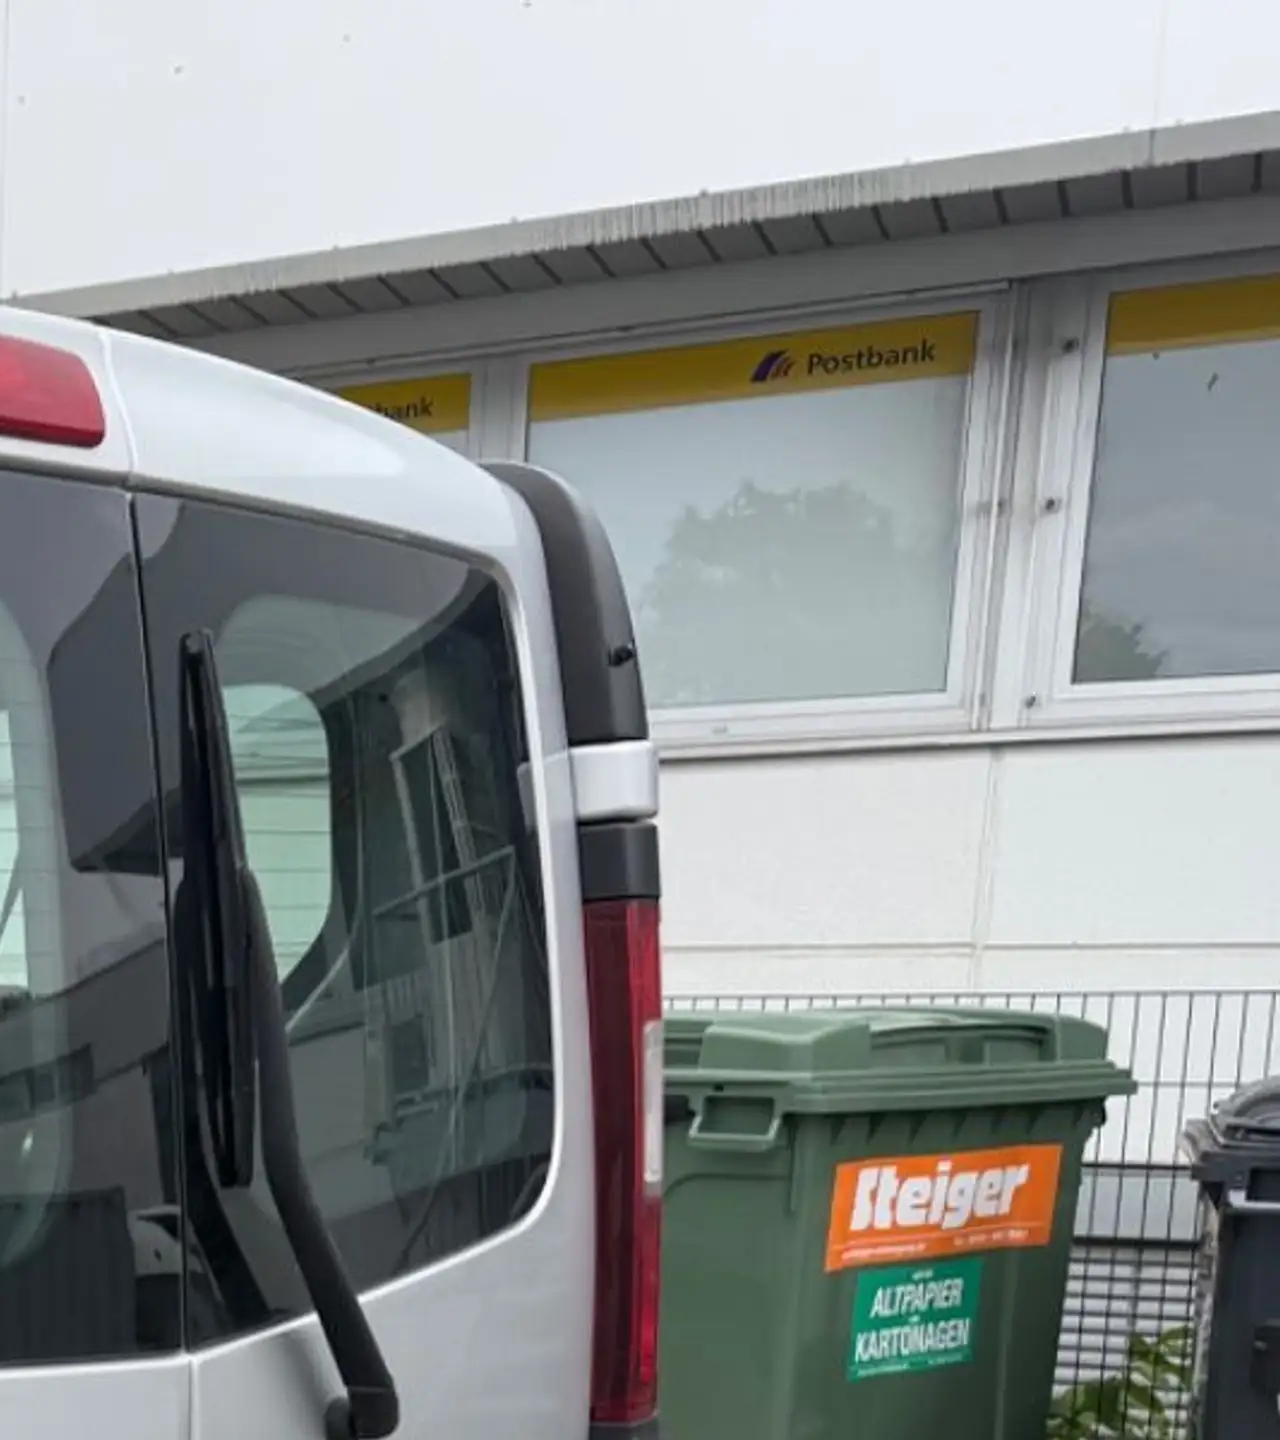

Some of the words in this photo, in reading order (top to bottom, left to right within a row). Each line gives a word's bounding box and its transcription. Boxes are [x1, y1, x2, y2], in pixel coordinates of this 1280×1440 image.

[807, 337, 935, 375] Postbank
[851, 1161, 1030, 1231] Steiger
[869, 1277, 964, 1318] ALTPAPIER
[855, 1318, 970, 1363] KARTONAGEN
